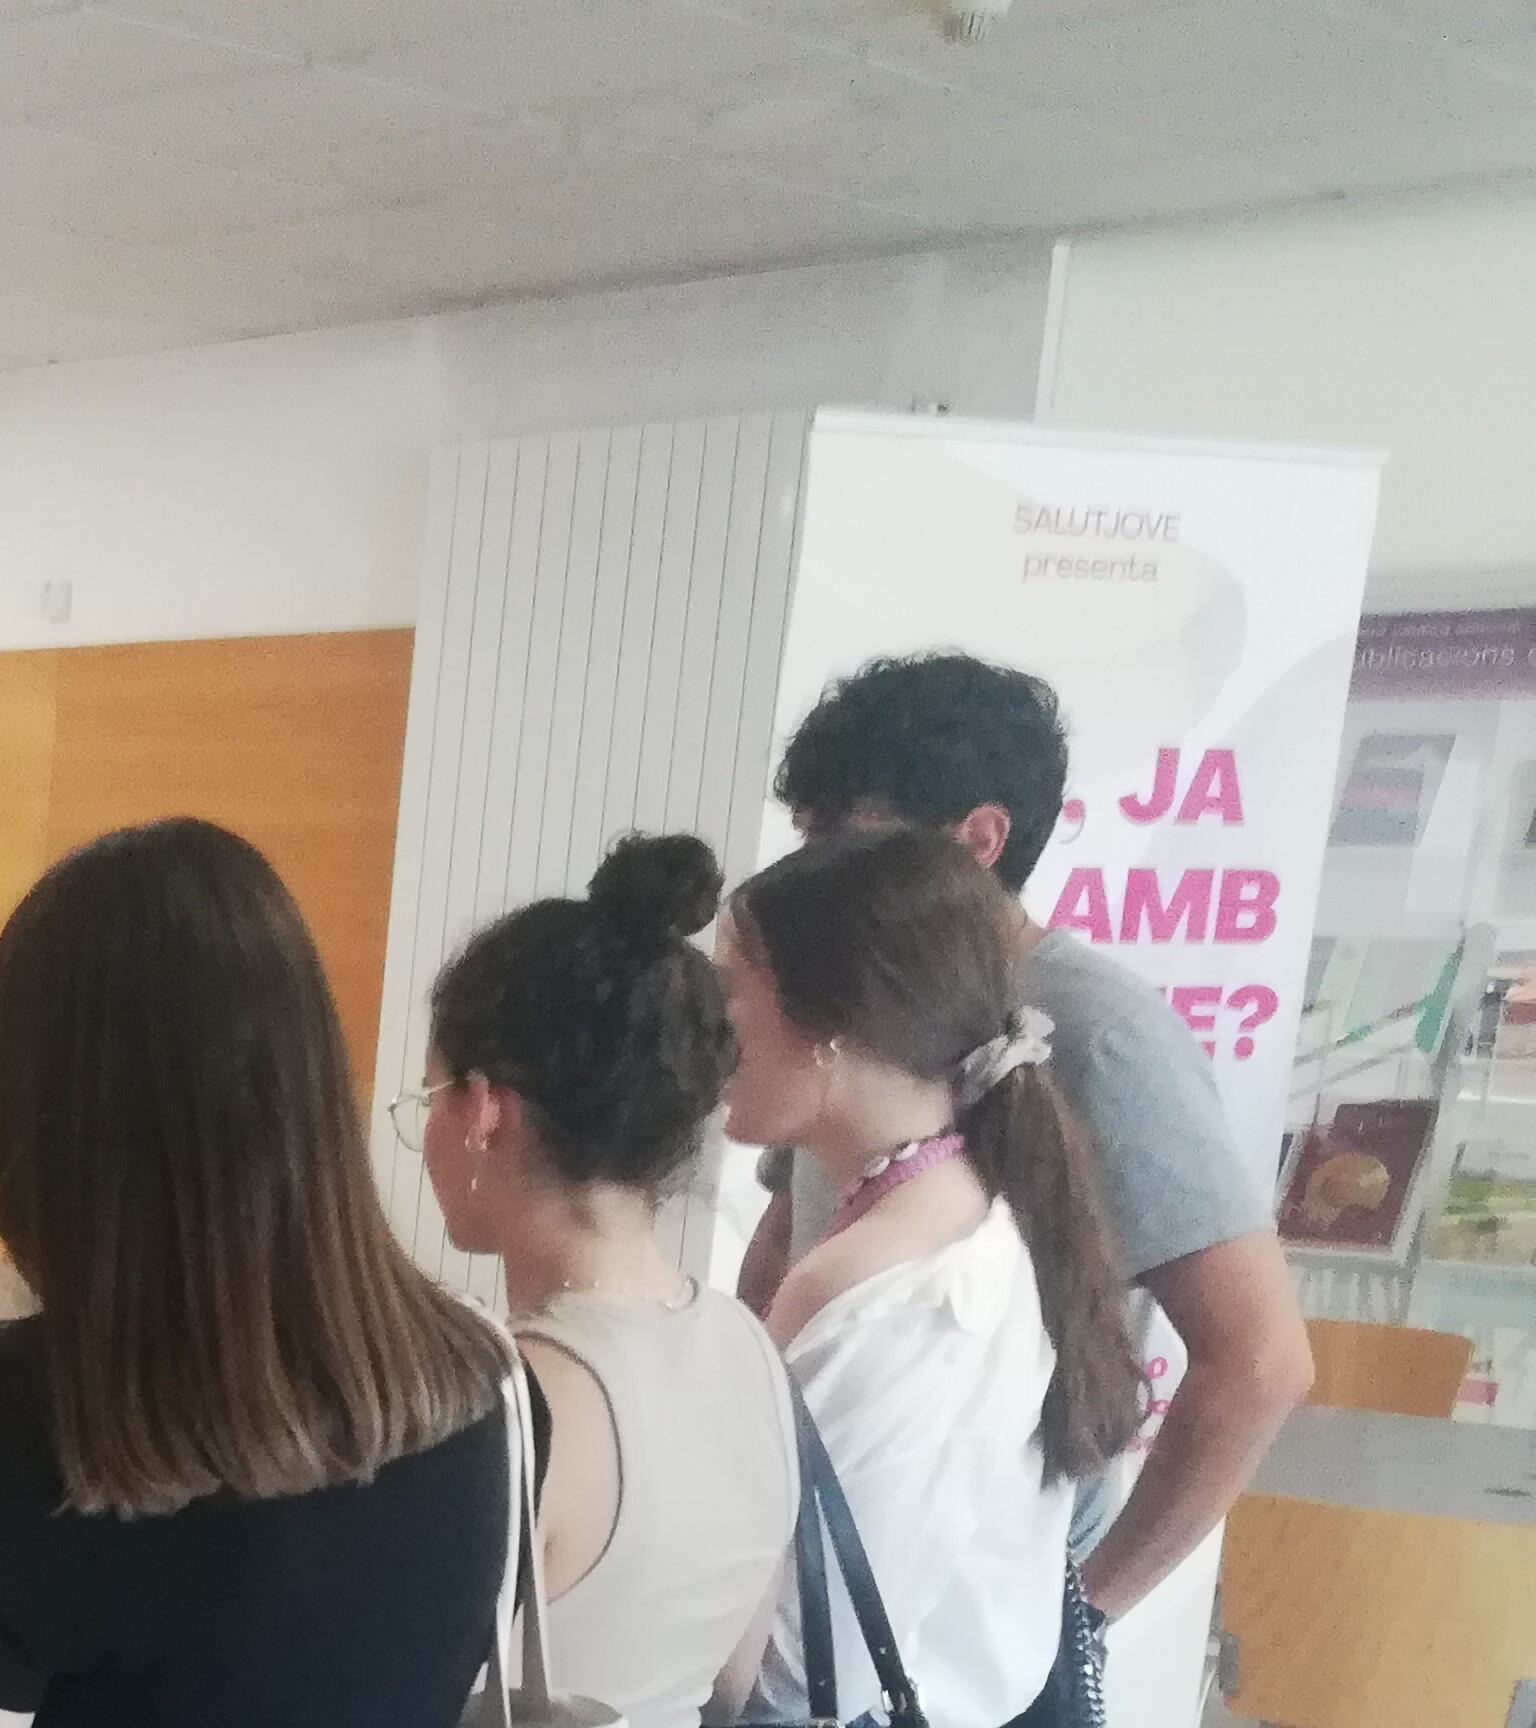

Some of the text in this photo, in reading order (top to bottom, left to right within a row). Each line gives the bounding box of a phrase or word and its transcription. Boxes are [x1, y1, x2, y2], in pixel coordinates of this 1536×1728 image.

[1013, 502, 1180, 543] SALUTJOVE
[1022, 552, 1159, 583] presenta
[1119, 748, 1244, 826] JA
[1046, 867, 1281, 944] AMB
